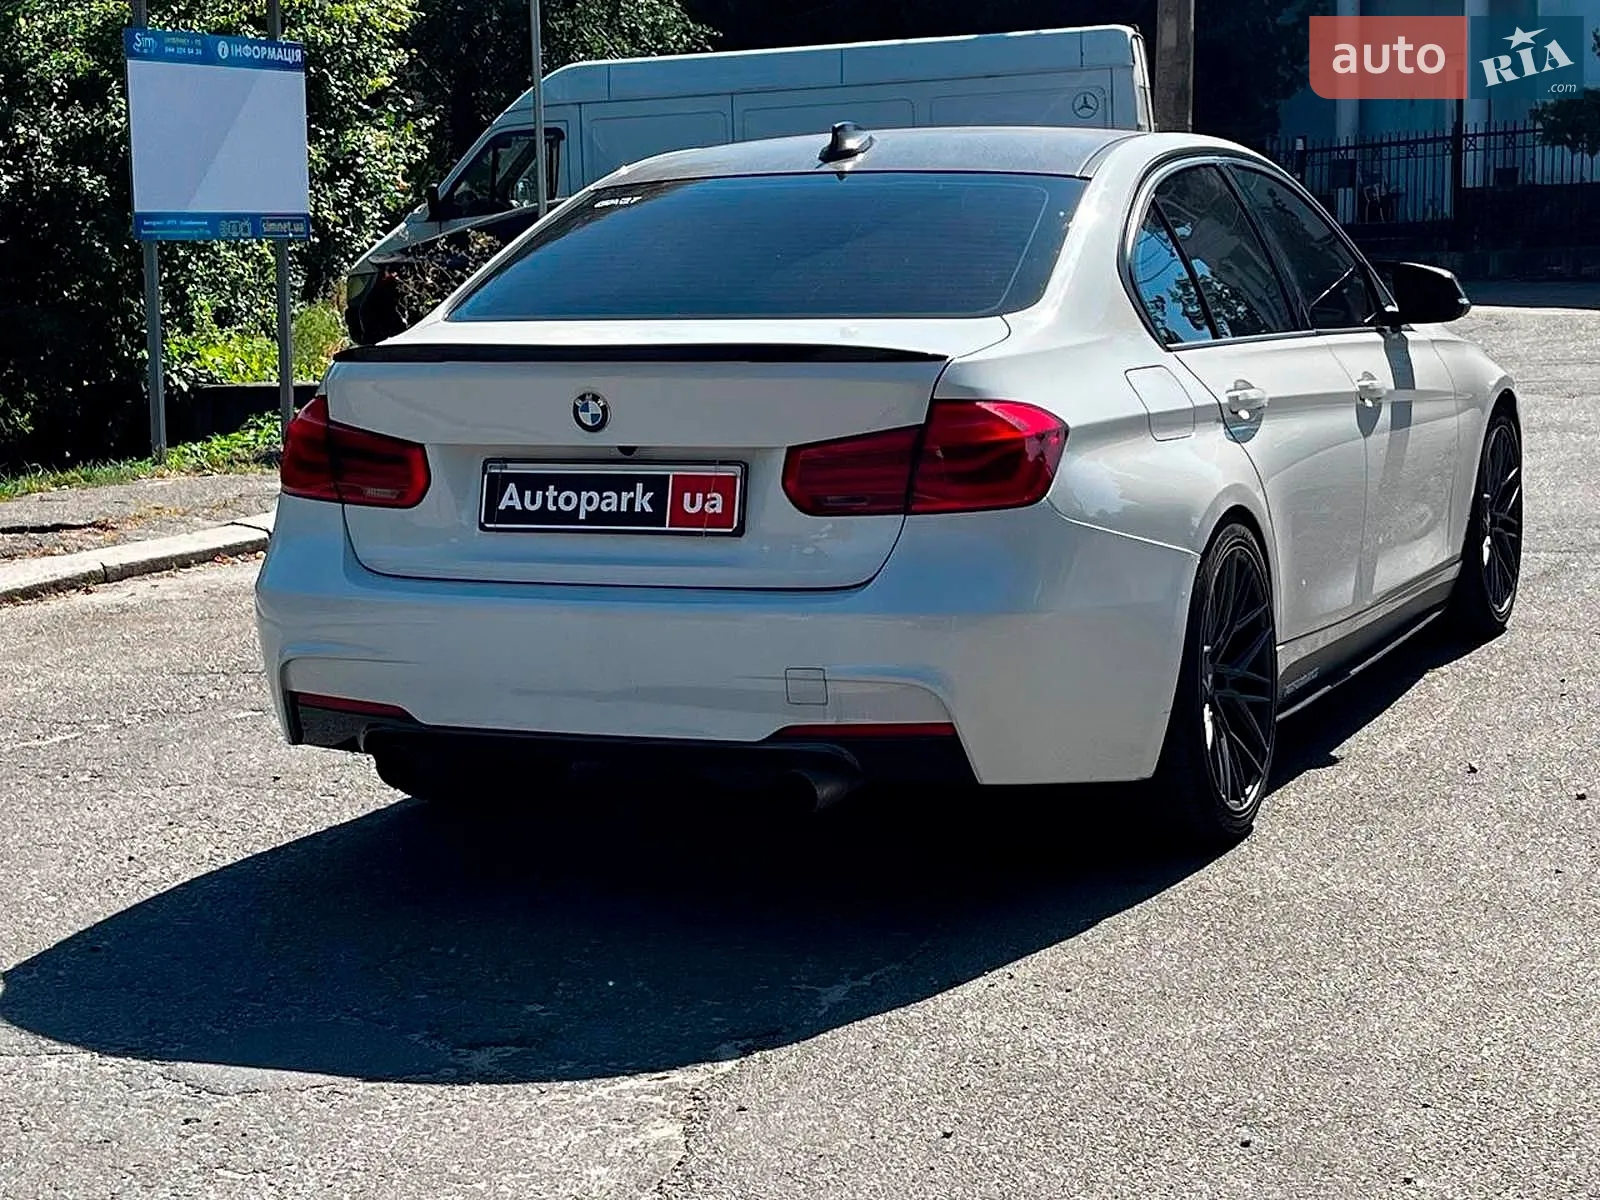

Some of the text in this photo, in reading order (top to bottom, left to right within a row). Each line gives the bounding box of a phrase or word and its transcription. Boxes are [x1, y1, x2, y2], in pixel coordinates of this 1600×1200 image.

[230, 43, 302, 64] ІНФОРМАЦІЯ
[497, 482, 724, 520] Autopark ua
